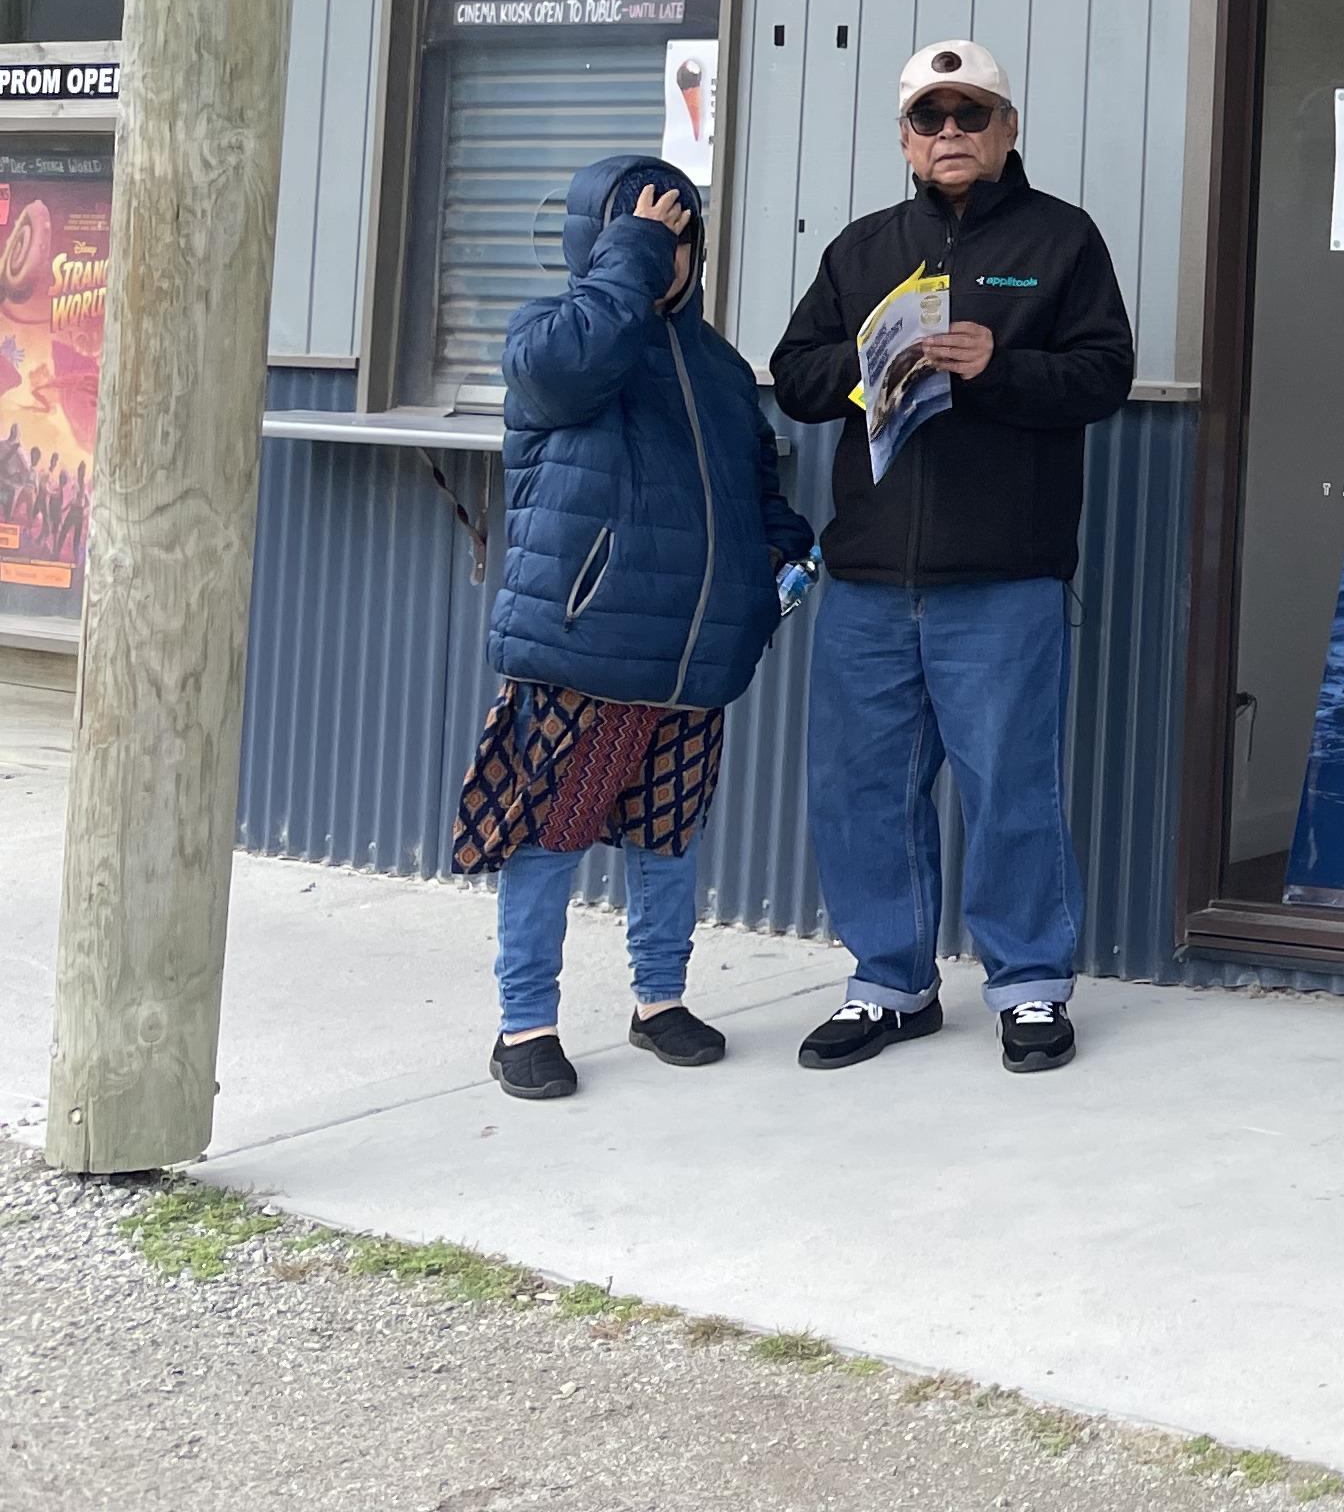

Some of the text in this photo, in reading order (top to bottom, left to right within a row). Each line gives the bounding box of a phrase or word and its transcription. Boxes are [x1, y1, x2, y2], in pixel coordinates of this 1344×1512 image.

[457, 2, 497, 24] CINEMA
[500, 2, 533, 24] KIOSK
[534, 0, 564, 23] OPEN
[629, 2, 656, 19] UNTIL
[660, 1, 685, 19] LATE
[0, 68, 61, 95] PROM
